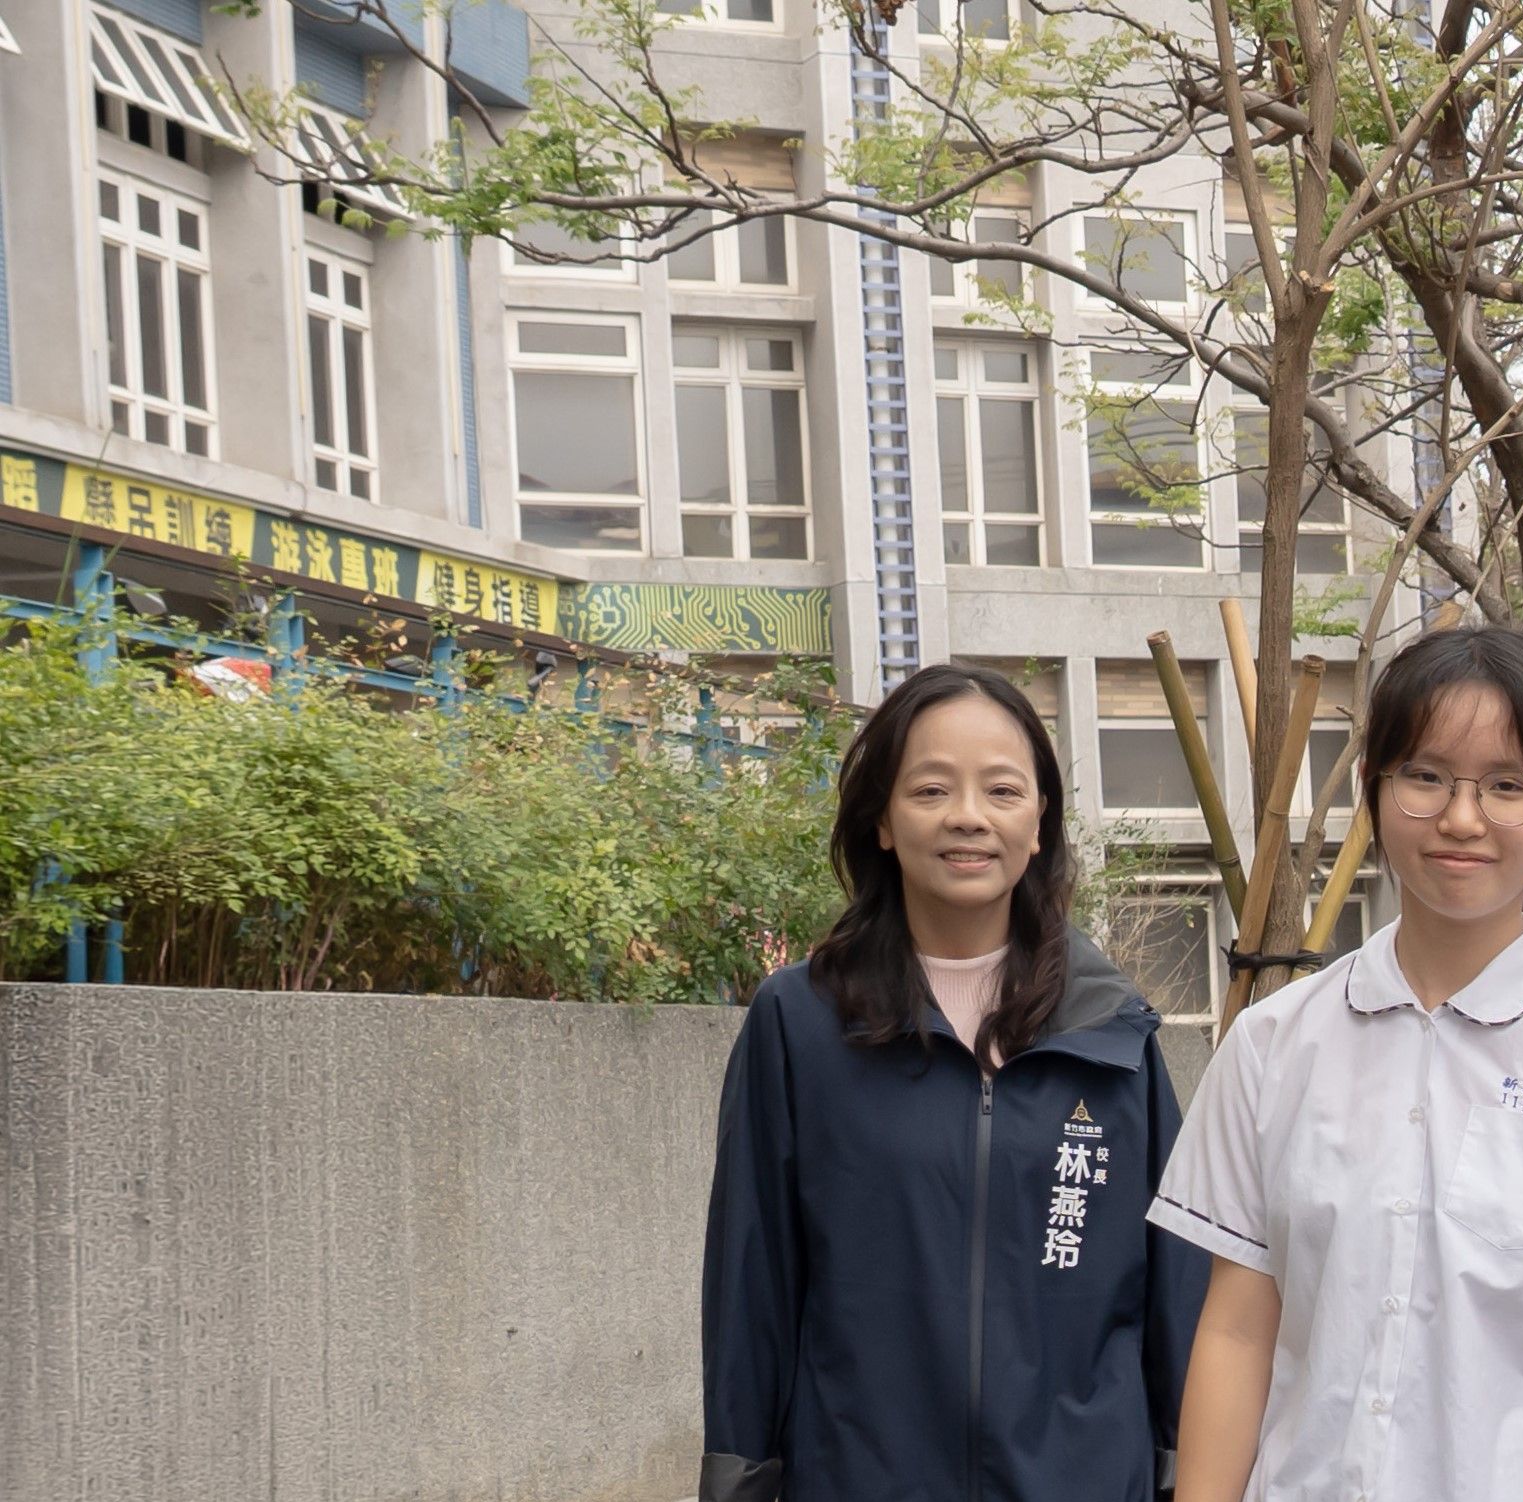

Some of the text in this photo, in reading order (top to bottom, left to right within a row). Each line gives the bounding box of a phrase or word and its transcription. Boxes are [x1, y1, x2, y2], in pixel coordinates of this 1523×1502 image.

[1041, 1141, 1092, 1269] 林燕玲
[1092, 1146, 1110, 1185] 校長
